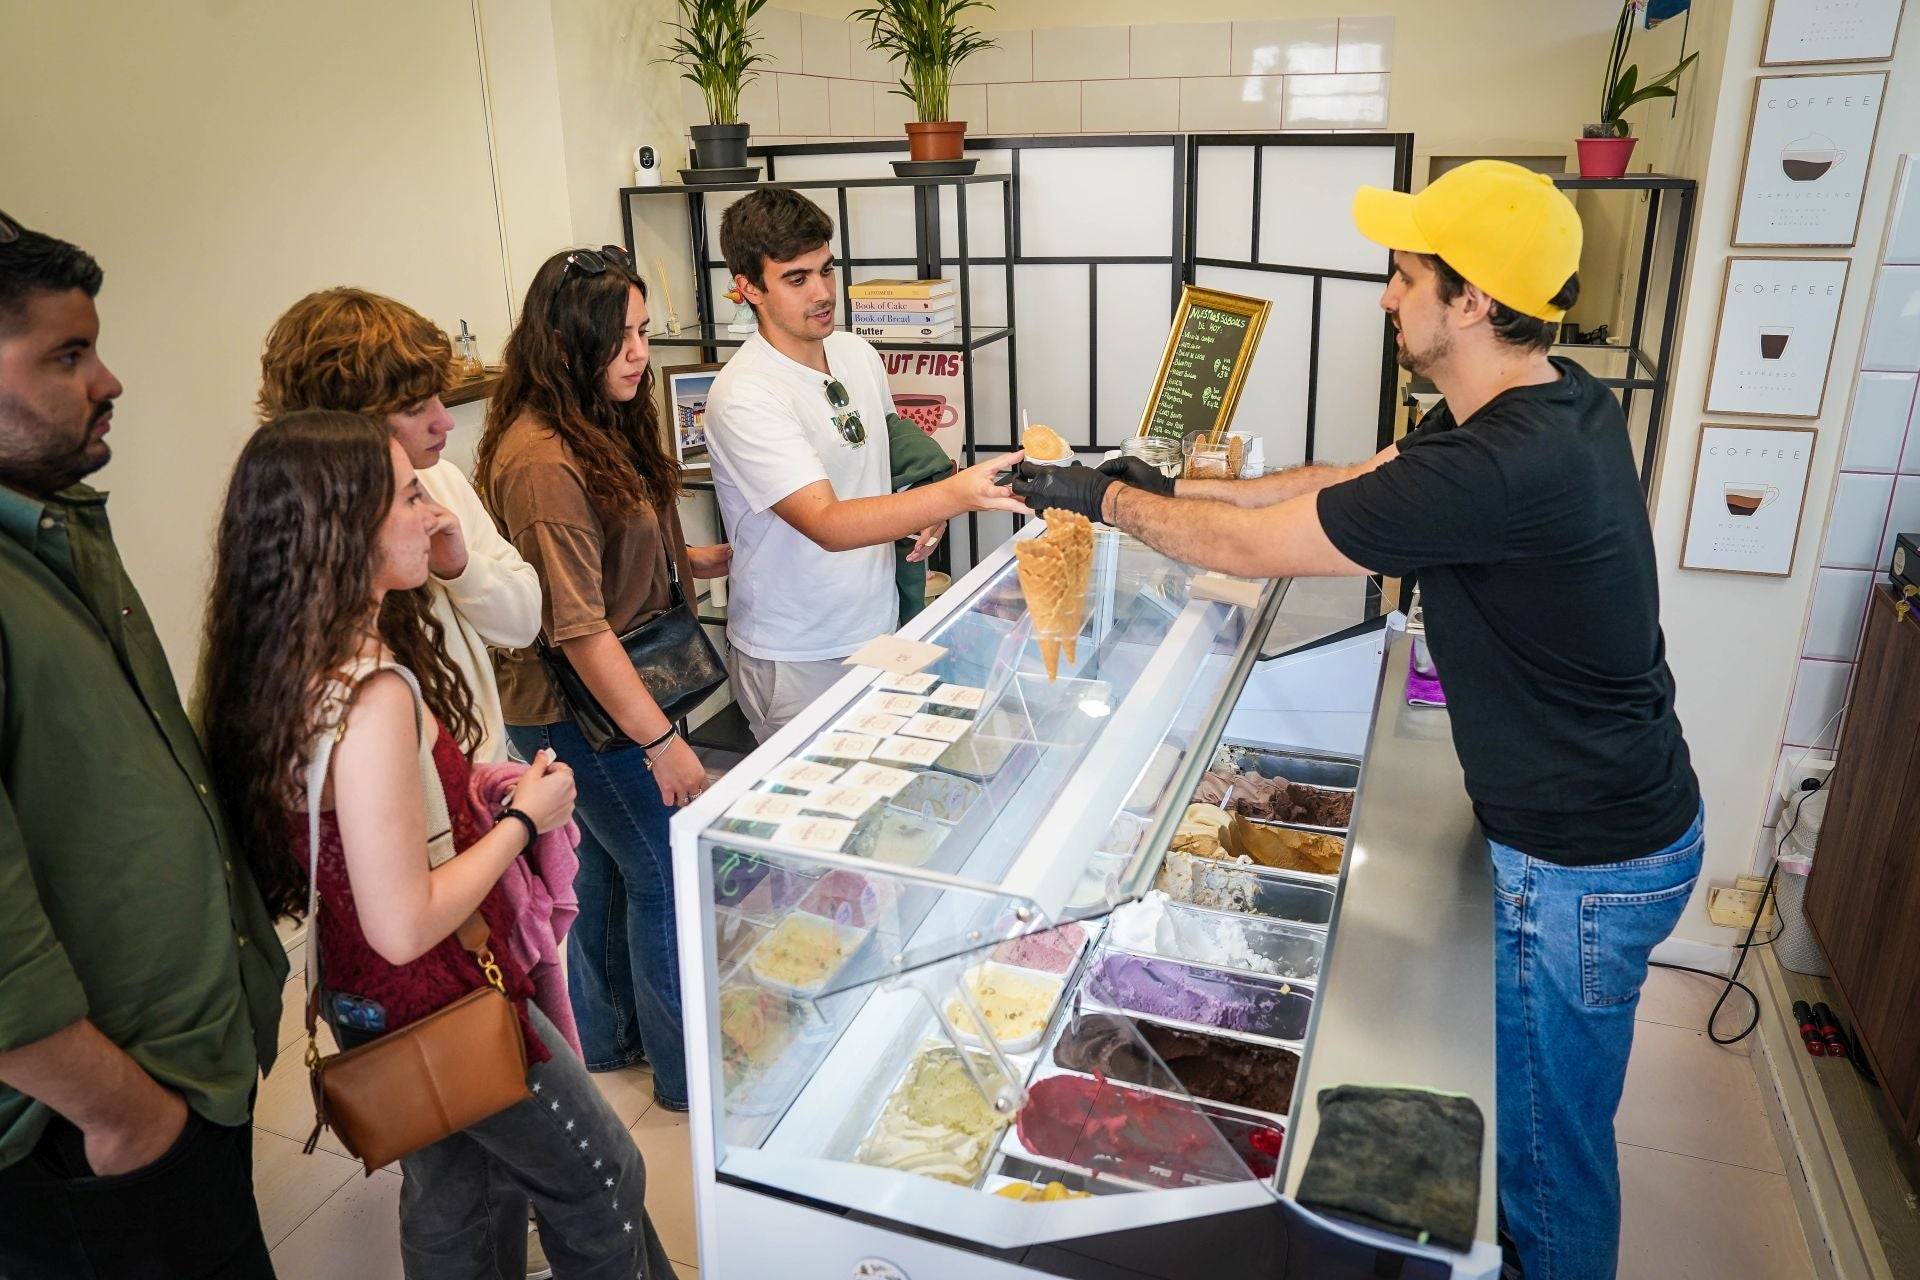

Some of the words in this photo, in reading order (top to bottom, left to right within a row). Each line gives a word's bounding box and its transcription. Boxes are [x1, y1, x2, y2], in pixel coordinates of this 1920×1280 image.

[1767, 95, 1871, 109] COFFEE
[1734, 283, 1834, 295] COFFEE
[855, 301, 876, 310] Book
[877, 301, 886, 310] of
[886, 302, 908, 310] Cake
[854, 314, 875, 323] Book
[877, 314, 886, 323] of
[887, 314, 910, 323] Bread
[856, 327, 884, 336] Butter
[915, 354, 964, 377] FIRS
[1709, 446, 1801, 460] COFFEE
